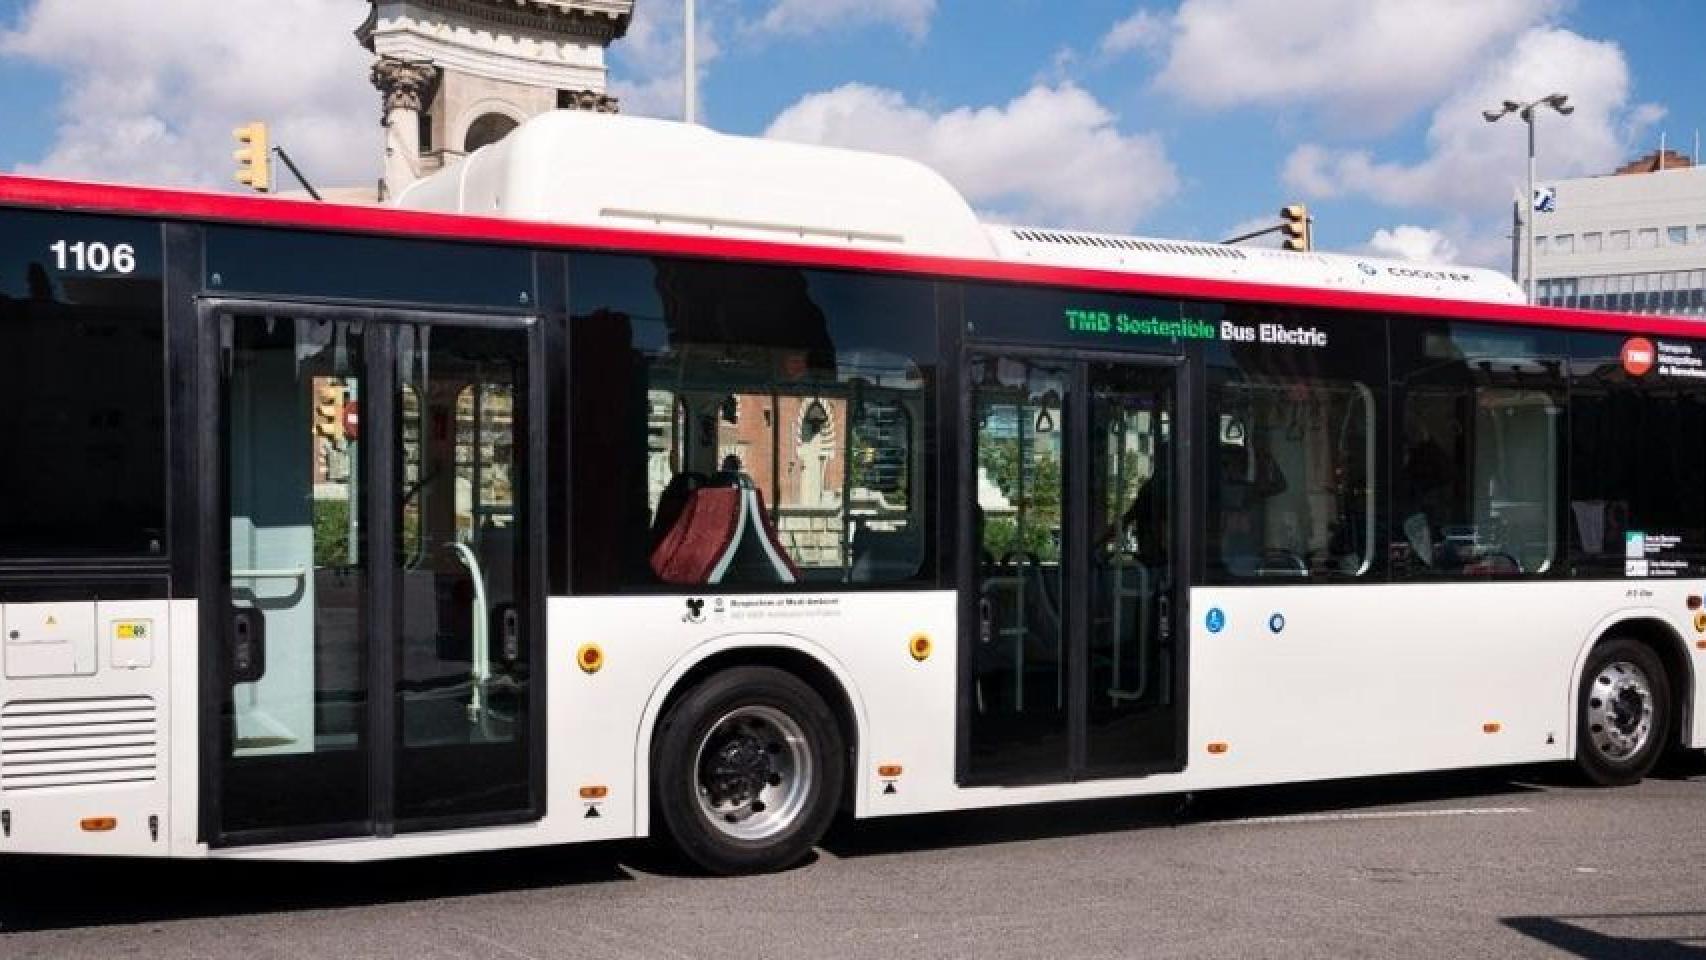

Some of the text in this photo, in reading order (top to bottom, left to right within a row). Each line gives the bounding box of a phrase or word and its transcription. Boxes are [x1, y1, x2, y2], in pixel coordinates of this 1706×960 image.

[49, 239, 136, 273] 1106
[1065, 309, 1110, 332] TMB
[1117, 313, 1215, 339] Sostenible
[1220, 320, 1256, 341] Bus
